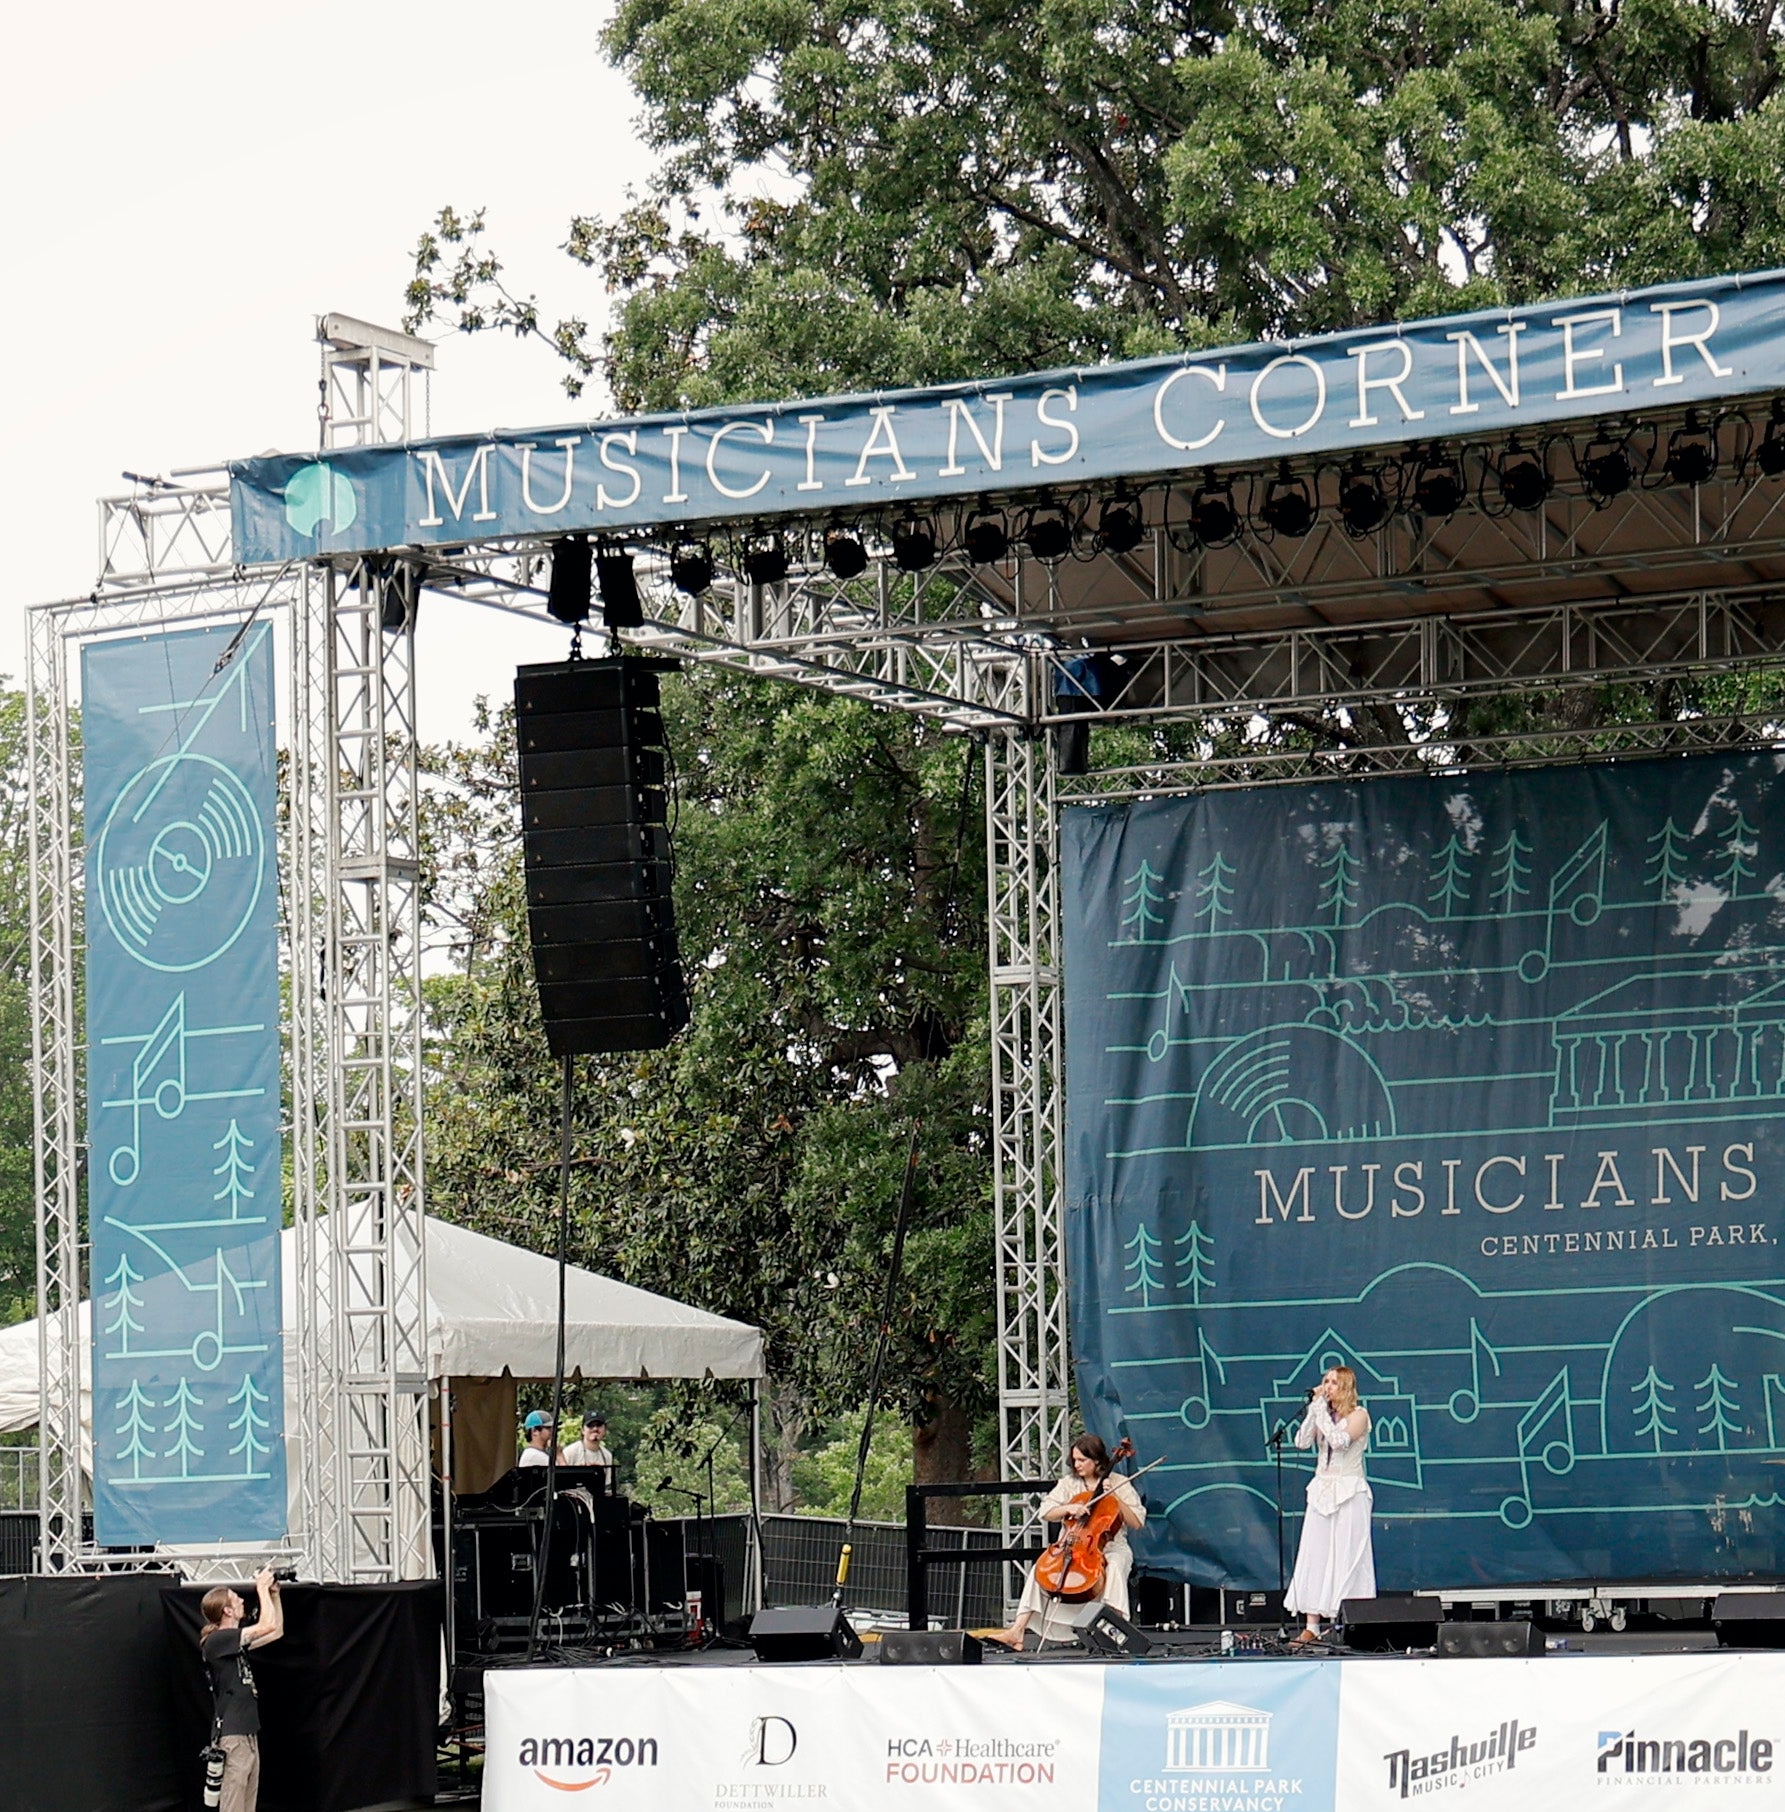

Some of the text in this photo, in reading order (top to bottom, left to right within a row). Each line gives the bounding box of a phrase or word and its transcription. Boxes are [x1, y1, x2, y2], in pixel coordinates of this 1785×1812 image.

[418, 298, 1733, 528] MUSICIANS CORNER
[1255, 1142, 1757, 1224] MUSICIANS
[1481, 1227, 1678, 1257] CENTENNIAL
[1690, 1222, 1778, 1246] PARK,
[519, 1736, 658, 1767] amazon
[887, 1739, 933, 1757] HCA
[1383, 1719, 1537, 1799] Nashville
[1597, 1729, 1773, 1773] Pinnacle
[886, 1763, 1054, 1784] FOUNDATION
[1130, 1779, 1303, 1794] CENTENNIAL PARK
[1412, 1760, 1505, 1796] MUSIC CITY
[1597, 1775, 1773, 1786] FINANCIAL PARTNERS
[715, 1784, 828, 1799] DETTWILLER
[1145, 1797, 1284, 1812] CONSERVANCY
[714, 1801, 774, 1809] FOUNDATION
